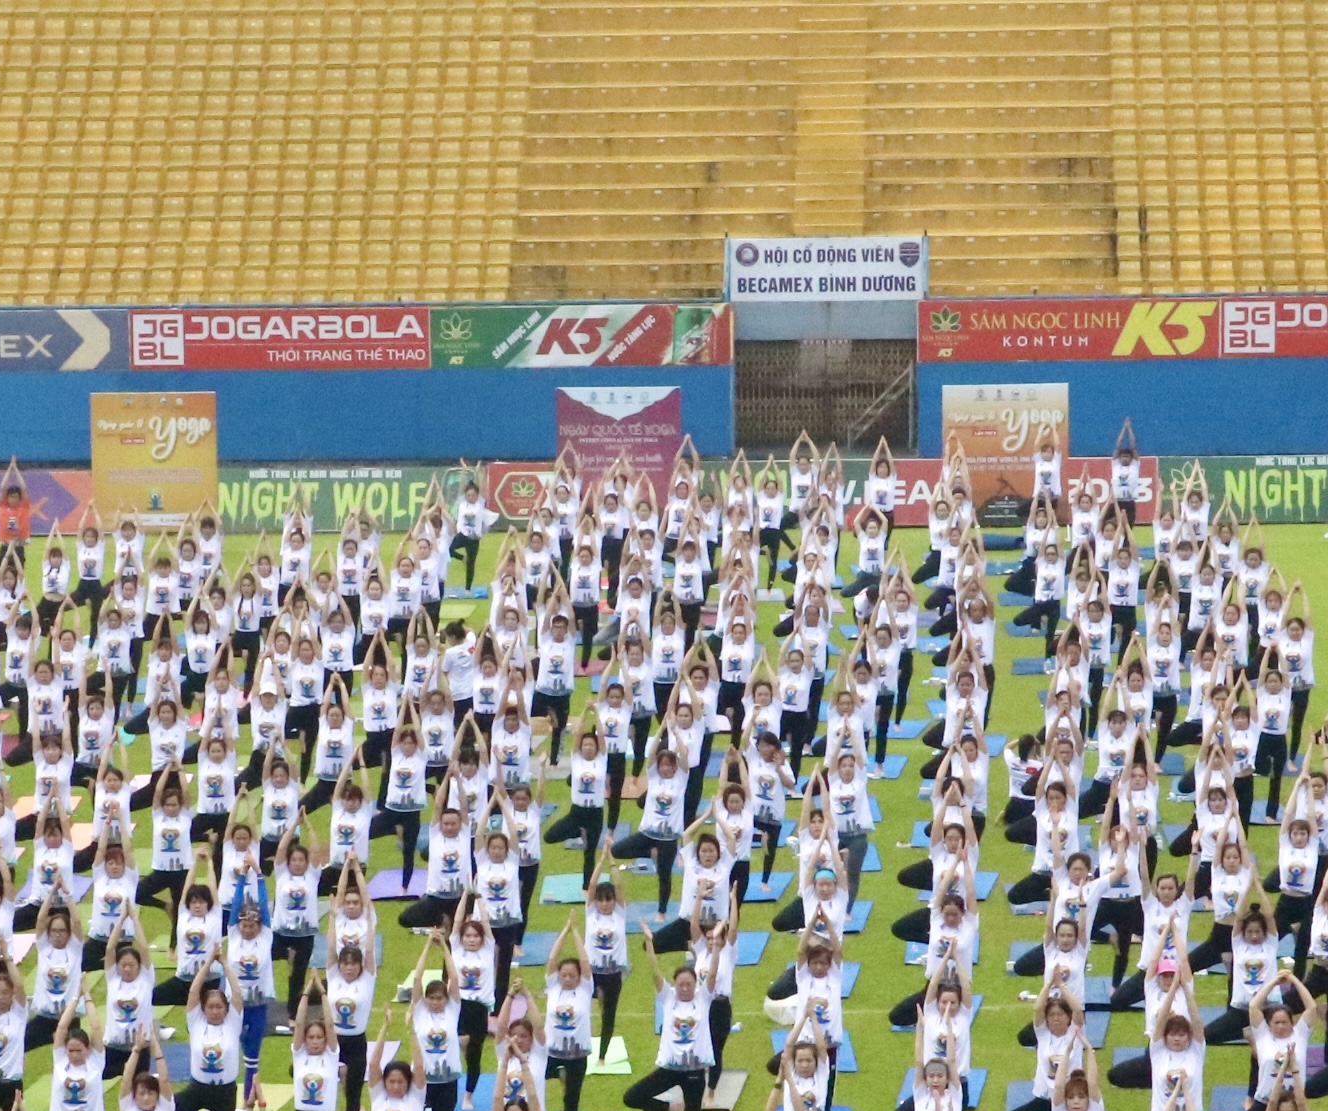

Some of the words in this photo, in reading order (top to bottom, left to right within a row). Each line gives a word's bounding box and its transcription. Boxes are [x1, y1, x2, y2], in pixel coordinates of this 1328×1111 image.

[763, 246, 788, 267] HỘI
[817, 246, 856, 266] ĐỘNG
[862, 245, 894, 263] VIÊN
[737, 276, 813, 293] BECAMEX
[819, 274, 856, 292] BÌNH
[862, 275, 916, 292] DƯƠNG
[185, 314, 424, 340] JOGARBOLA
[970, 308, 1007, 330] SÂM
[1013, 312, 1068, 331] NGỌC
[1074, 311, 1120, 329] LINH
[1111, 301, 1218, 356] K5
[535, 317, 610, 356] K5
[1002, 335, 1090, 347] KONTUM
[303, 349, 352, 361] TRANG
[386, 348, 426, 360] THAO
[1068, 478, 1153, 503] 203
[1225, 468, 1328, 521] NIGHT
[218, 480, 319, 528] NIGHT
[333, 480, 429, 530] WOLF
